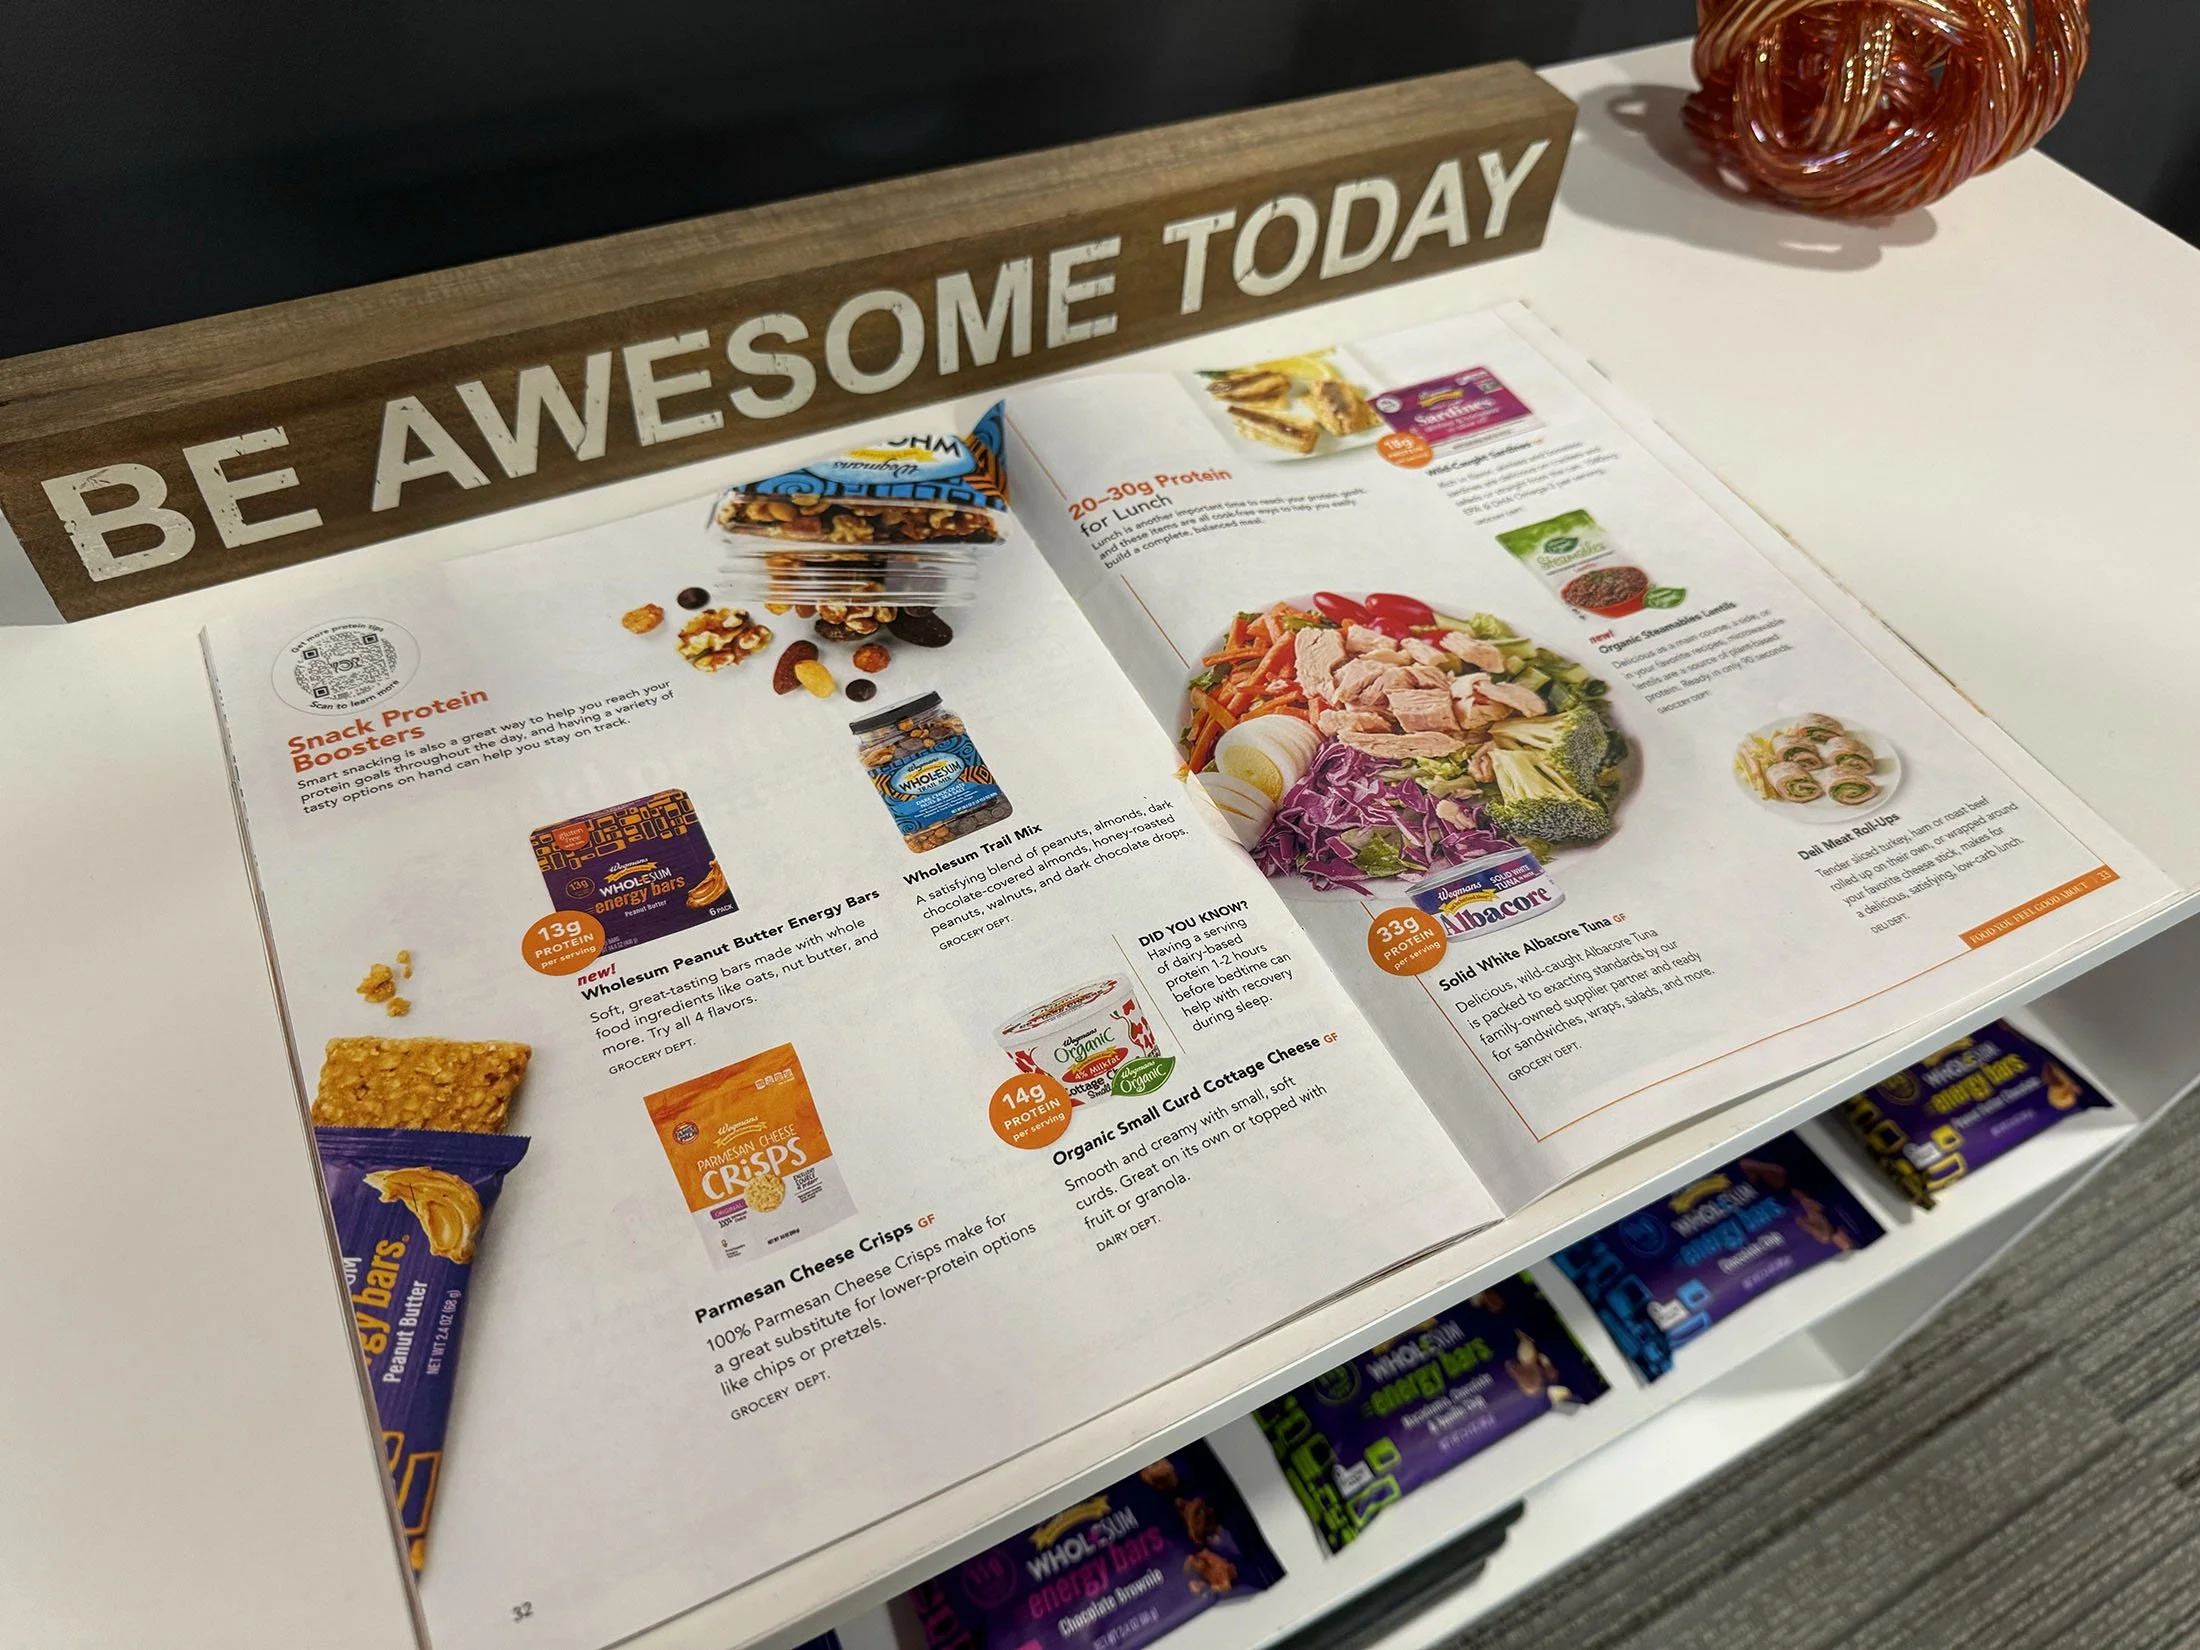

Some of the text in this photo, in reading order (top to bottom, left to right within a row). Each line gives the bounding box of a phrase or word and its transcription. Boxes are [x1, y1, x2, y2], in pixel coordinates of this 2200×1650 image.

[43, 140, 1550, 583] BE AWESOME TODAY
[1155, 468, 1232, 488] Protein
[1080, 495, 1173, 537] for Lunch
[291, 623, 384, 653] Get more protein tips
[1598, 602, 1737, 654] Organic Steamables Lentils
[310, 701, 333, 710] Scan
[350, 695, 376, 708] learn
[377, 679, 400, 696] more
[287, 691, 488, 754] Snack Protein
[290, 715, 425, 773] Boosters
[304, 717, 630, 814] tasty options on hand can help you stay on track.
[899, 761, 962, 792] WHOLESUM
[918, 776, 952, 792] TRAIL MIX
[902, 824, 1042, 885] Wholesum Trail Mix
[1797, 813, 1900, 860] Deli Meat Roll-Ups
[599, 868, 672, 897] WHOLESUM
[609, 858, 648, 873] Wegmans
[923, 813, 1175, 919] chocolate-covered almonds, honey-roasted
[1490, 864, 1531, 884] SOLID WHITE
[2097, 871, 2112, 880] 33
[568, 879, 588, 892] 13g
[595, 875, 686, 914] energy bars
[1438, 882, 1482, 901] Wegmans
[1495, 878, 1520, 892] TUNA
[624, 900, 667, 918] Peanut Butter
[709, 903, 734, 916] 6 PACK
[1138, 900, 1248, 947] DID YOU KNOW?
[1440, 887, 1551, 936] Albacore
[535, 933, 594, 959] PROTEIN
[538, 919, 582, 942] 13g
[580, 890, 879, 1000] Wholesum Peanut Butter Energy Bars
[1376, 915, 1420, 943] 33g
[1383, 928, 1435, 961] PROTEIN
[541, 945, 597, 970] per serving
[1394, 941, 1441, 971] per serving
[1438, 913, 1625, 991] Solid White Albacore Tuna GF
[577, 962, 616, 987] new!
[589, 919, 865, 1023] Soft, great-tasting bars made with whole
[1171, 954, 1291, 1002] before bedtime can
[1192, 995, 1272, 1031] during sleep.
[1491, 969, 1715, 1061] for sandwiches, wraps, salads, and more.
[1054, 1026, 1116, 1064] Organic
[1063, 1027, 1098, 1047] Wegmans
[608, 1038, 696, 1074] GROCERY DEPT.
[1074, 1055, 1121, 1081] 4% Milkfat
[1121, 1060, 1156, 1079] Wegmans
[1120, 1063, 1167, 1093] Organic
[1001, 1083, 1047, 1110] 14g
[1003, 1098, 1061, 1130] PROTEIN
[1053, 1032, 1337, 1165] Organic Small Curd Cottage Cheese GF
[717, 1115, 759, 1135] Wegmans
[1012, 1112, 1066, 1142] per serving
[696, 1123, 798, 1172] PARMESAN CHEESE
[1084, 1174, 1190, 1229] fruit or granola.
[1096, 1214, 1161, 1252] DAIRY DEPT.
[695, 1214, 934, 1324] Parmesan Cheese Crisps GF
[382, 1280, 428, 1383] Peanut Butter
[720, 1317, 886, 1396] like chips or pretzels.
[730, 1370, 830, 1420] GROCERY DEPT.
[1026, 1504, 1139, 1582] WHOLESUM
[1029, 1525, 1166, 1619] energy bars
[512, 1601, 533, 1623] 32
[1058, 1568, 1165, 1637] Chocolate Brownie
